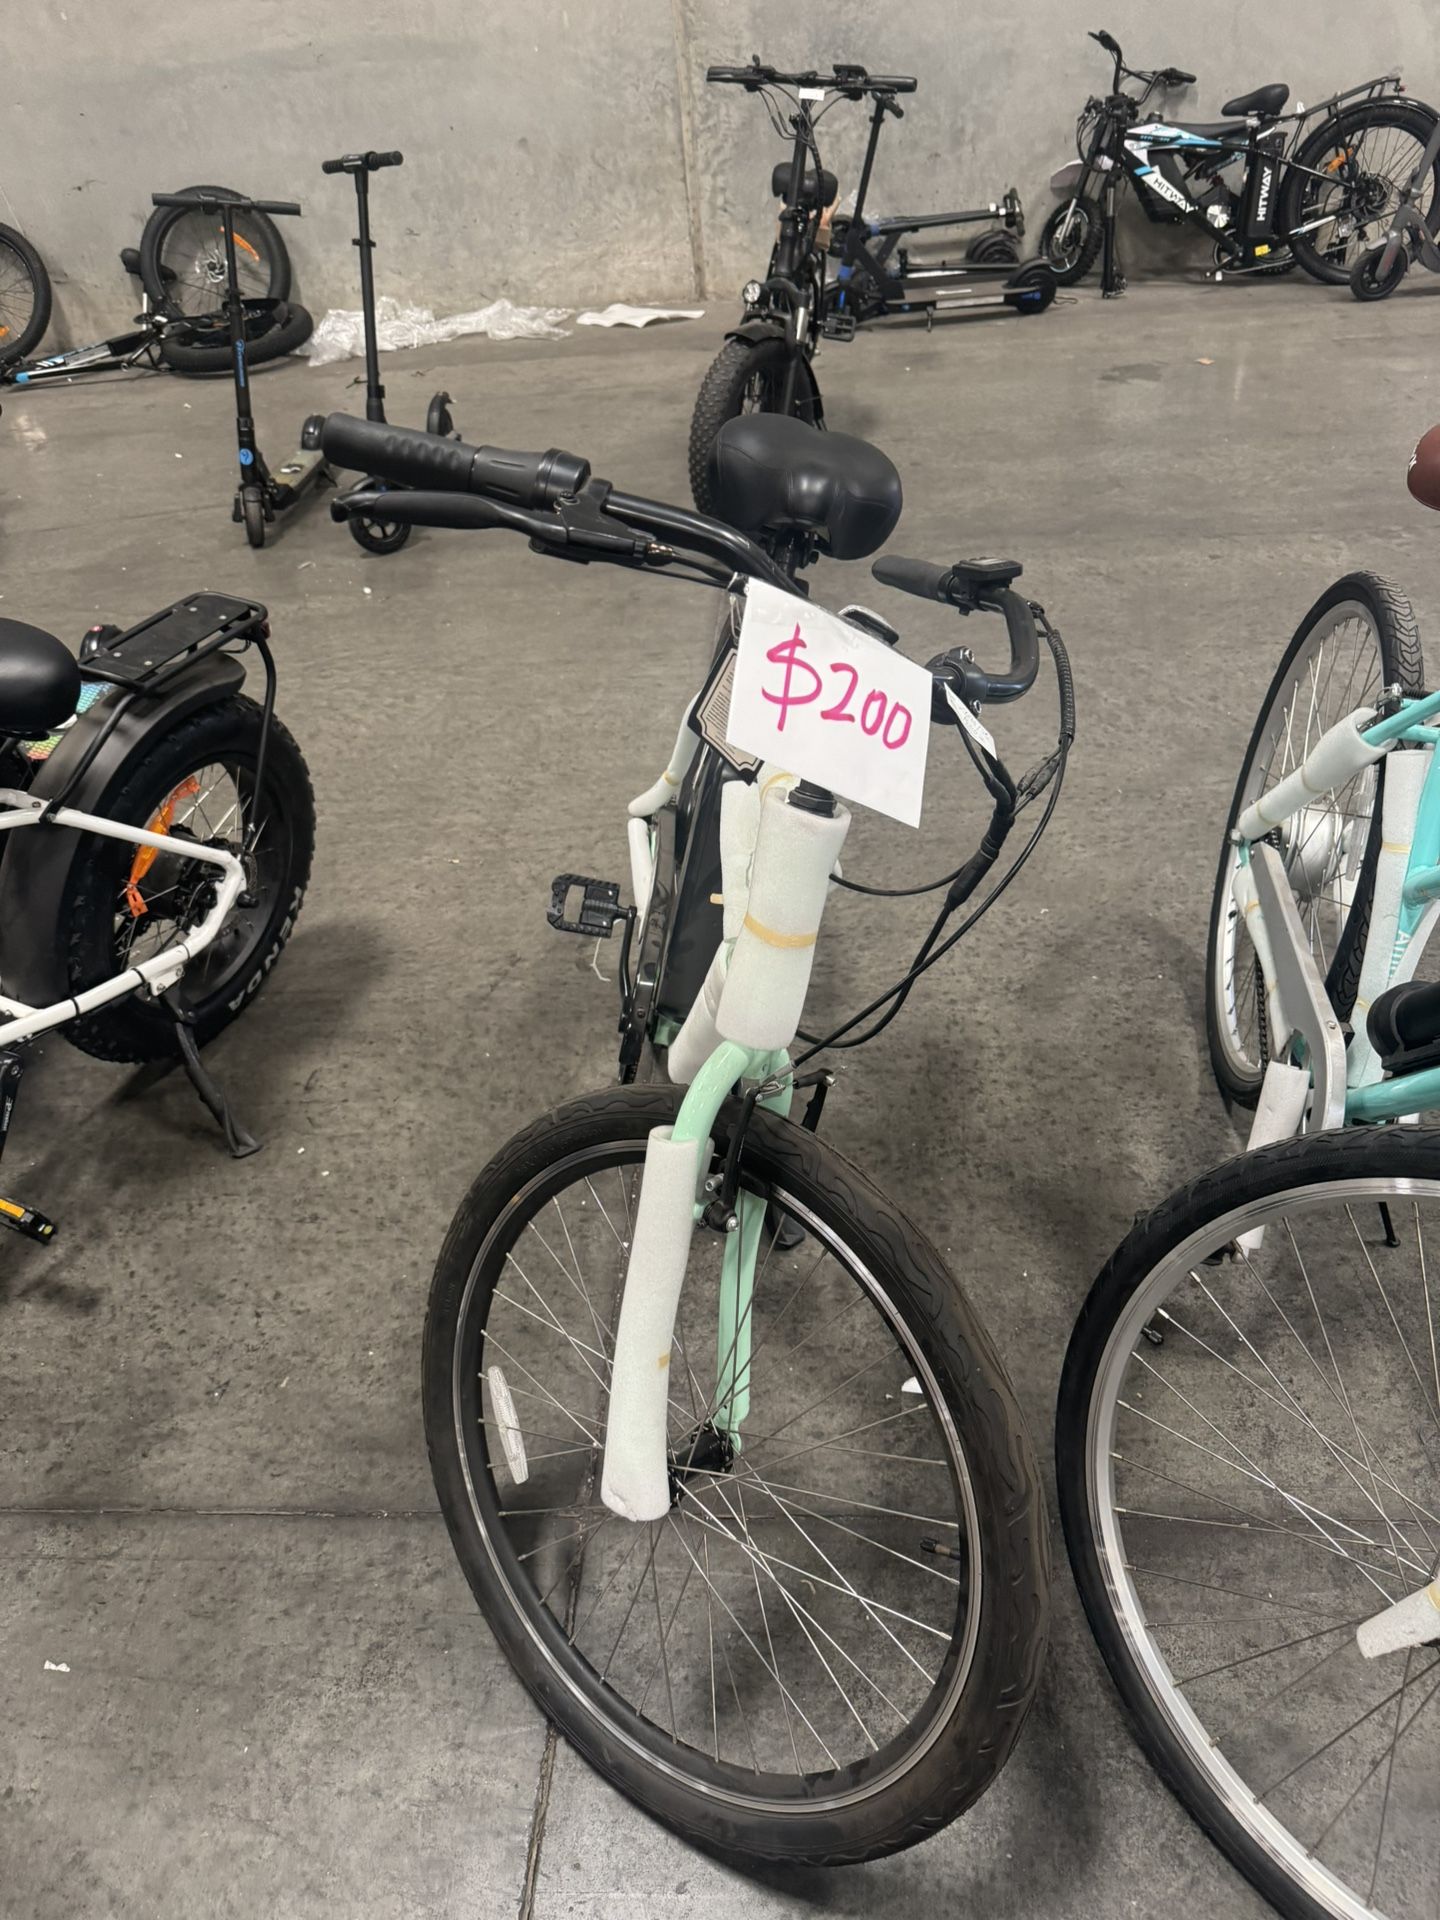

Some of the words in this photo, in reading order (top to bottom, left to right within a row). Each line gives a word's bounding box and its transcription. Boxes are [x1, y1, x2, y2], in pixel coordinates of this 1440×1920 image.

[1153, 178, 1195, 213] HITWAY
[1256, 166, 1273, 221] HITWAY
[761, 623, 912, 750] $200
[228, 886, 302, 1011] KENDA
